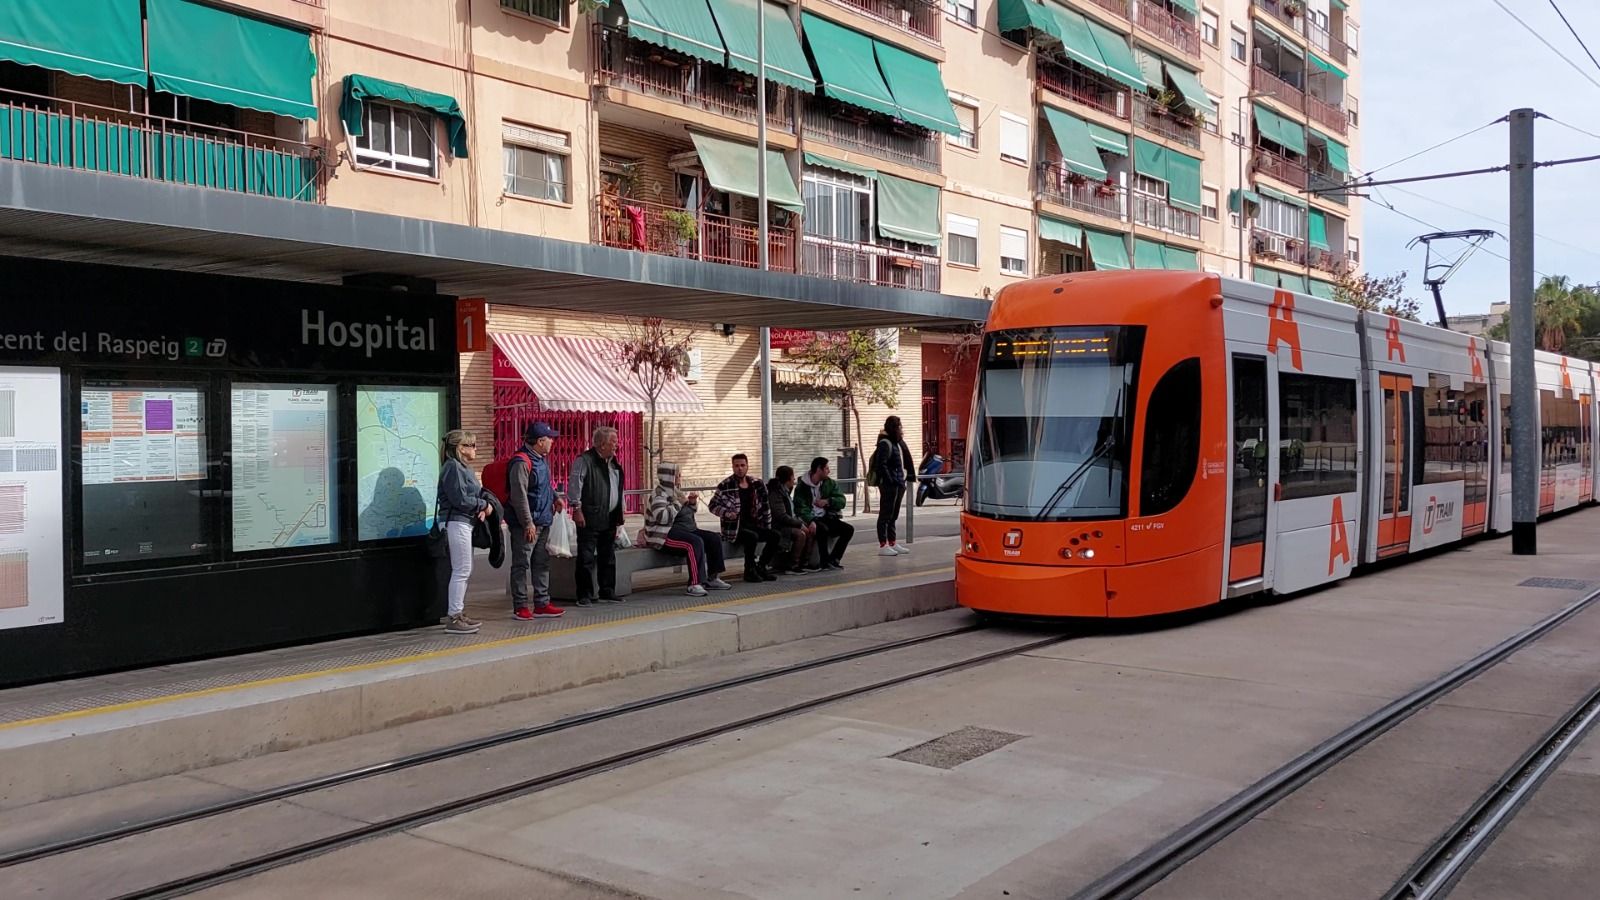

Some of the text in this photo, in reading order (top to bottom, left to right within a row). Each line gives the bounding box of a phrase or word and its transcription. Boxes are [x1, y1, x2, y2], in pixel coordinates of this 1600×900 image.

[53, 331, 87, 352] del
[98, 332, 179, 360] Raspeig
[189, 341, 198, 353] 2
[301, 309, 435, 358] Hospital
[463, 315, 472, 349] 1
[1267, 288, 1303, 372] A
[1385, 314, 1406, 363] A
[497, 358, 514, 369] YO
[1436, 501, 1454, 519] TRAM
[1328, 495, 1350, 576] A
